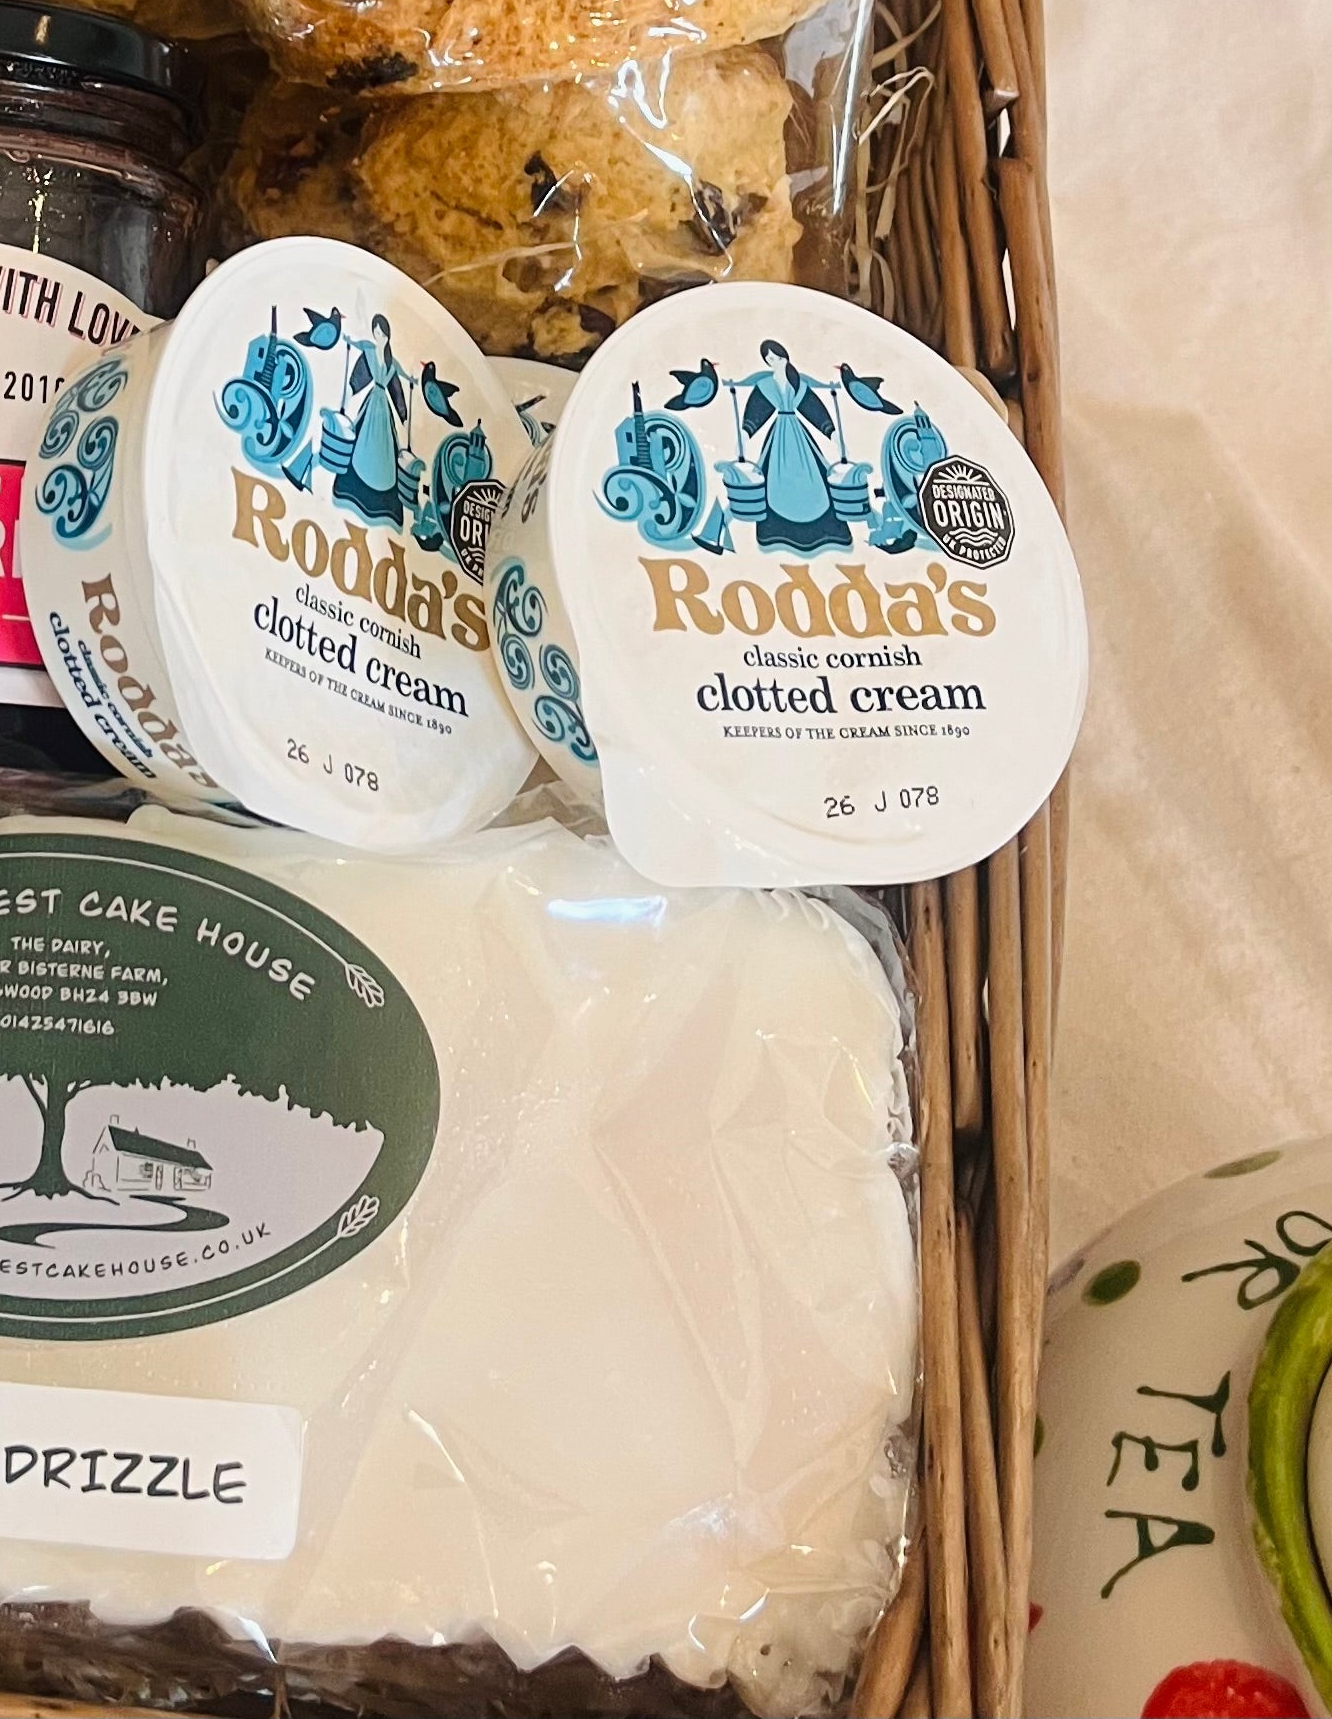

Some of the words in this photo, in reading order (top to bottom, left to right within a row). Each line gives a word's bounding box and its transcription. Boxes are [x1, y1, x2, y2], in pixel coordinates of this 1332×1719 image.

[67, 290, 141, 346] LOV
[932, 484, 995, 502] DESIGNATED
[932, 499, 1005, 530] ORIGIN
[230, 465, 492, 653] Rodda's
[958, 535, 1007, 561] PROTECTED
[638, 556, 997, 641] Rodda's
[295, 583, 355, 627] classic
[359, 615, 422, 660] cornish
[254, 595, 358, 675] clotted
[365, 656, 470, 719] cream
[743, 644, 820, 669] classic
[825, 643, 923, 669] cornish
[695, 672, 838, 715] clotted
[849, 682, 987, 714] cream
[723, 725, 782, 738] KEEPERS
[785, 726, 802, 739] OF
[808, 727, 835, 739] THE
[839, 726, 891, 738] CREAM
[894, 724, 938, 737] SINCE
[941, 725, 971, 739] 1890
[286, 737, 311, 765] 26
[322, 753, 334, 775] J
[343, 762, 380, 792] 078
[823, 795, 856, 818] 26
[874, 790, 887, 812] J
[899, 785, 940, 808] 078
[10, 936, 45, 953] THE
[51, 938, 111, 959] DAIRY,
[79, 890, 180, 933] CAKE
[196, 918, 317, 1003] HOUSE
[18, 960, 105, 980] BISTERNE
[111, 966, 168, 987] FARM,
[60, 987, 110, 1003] BH24
[0, 1014, 116, 1035] 01425471616
[4, 1444, 247, 1505] DRIZZLE
[1101, 1370, 1231, 1600] TEA
